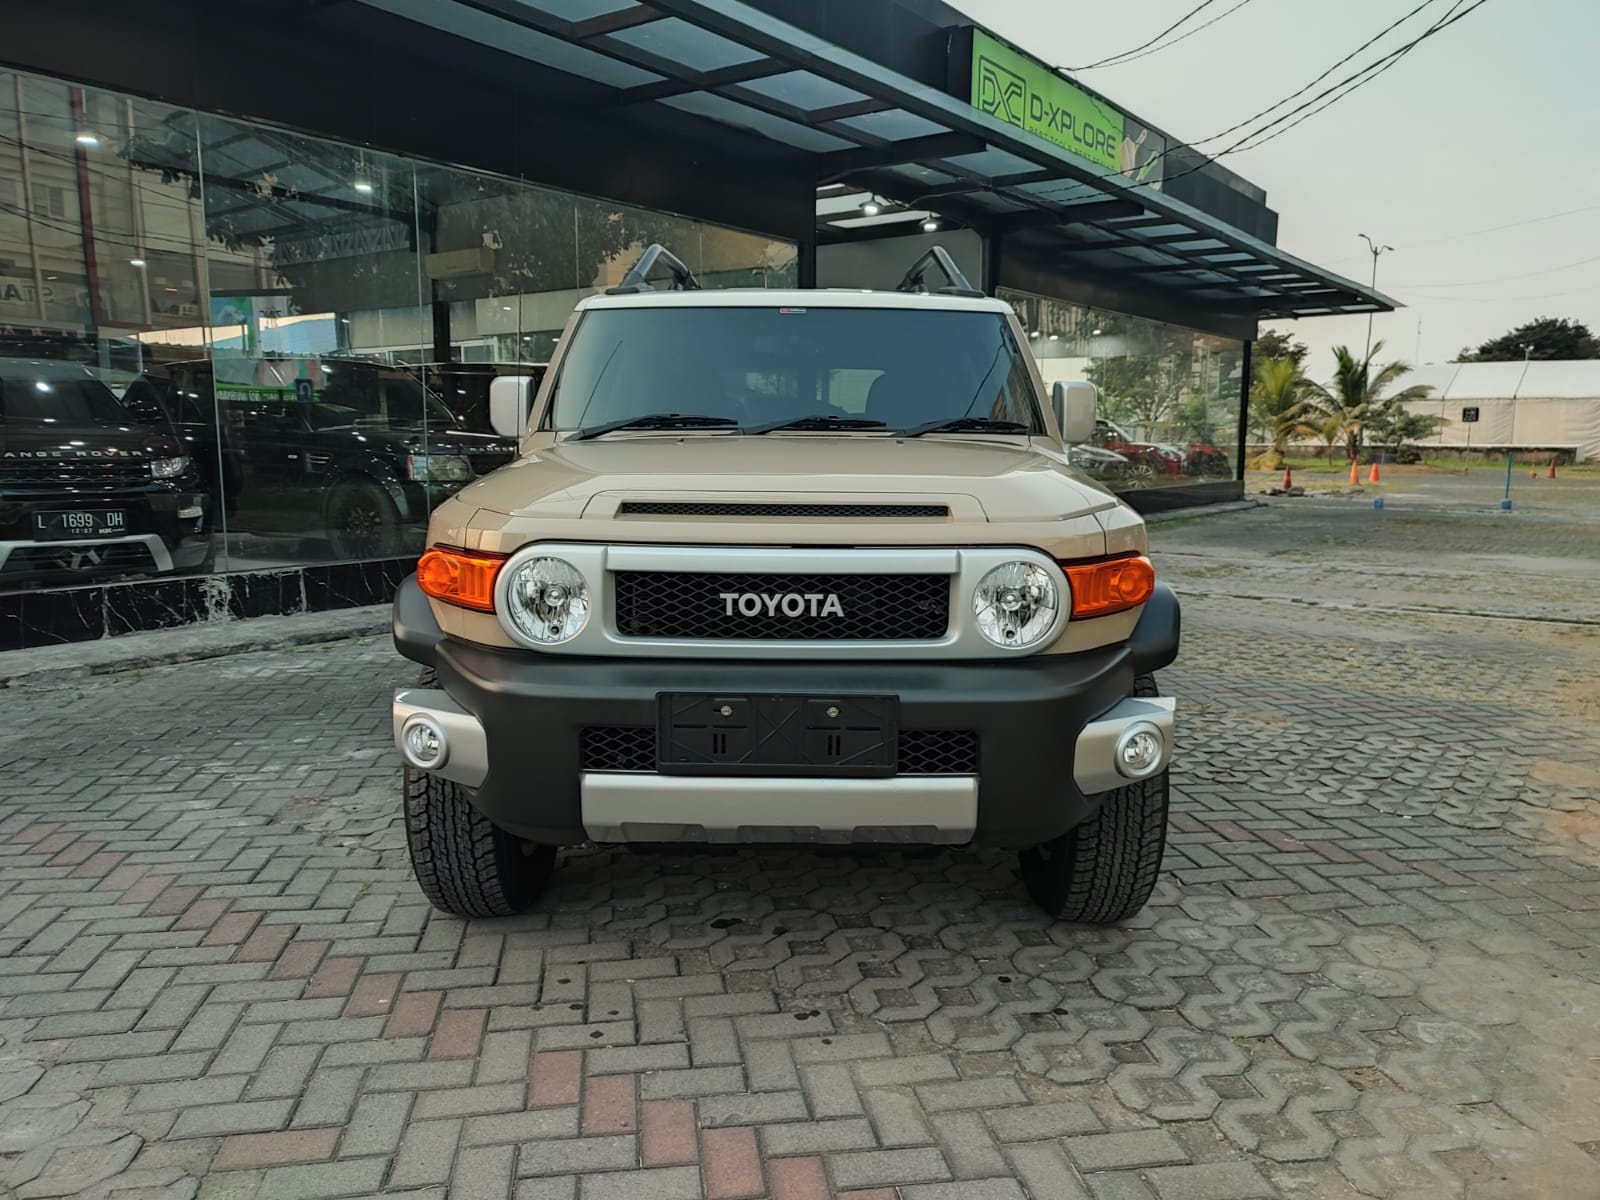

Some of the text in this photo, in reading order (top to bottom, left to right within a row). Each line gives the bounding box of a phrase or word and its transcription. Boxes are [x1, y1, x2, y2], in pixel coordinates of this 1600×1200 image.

[1030, 93, 1116, 159] D-XPLORE
[75, 449, 142, 457] ROVER
[37, 511, 123, 529] L 1699 DH
[719, 592, 845, 618] TOYOTA
